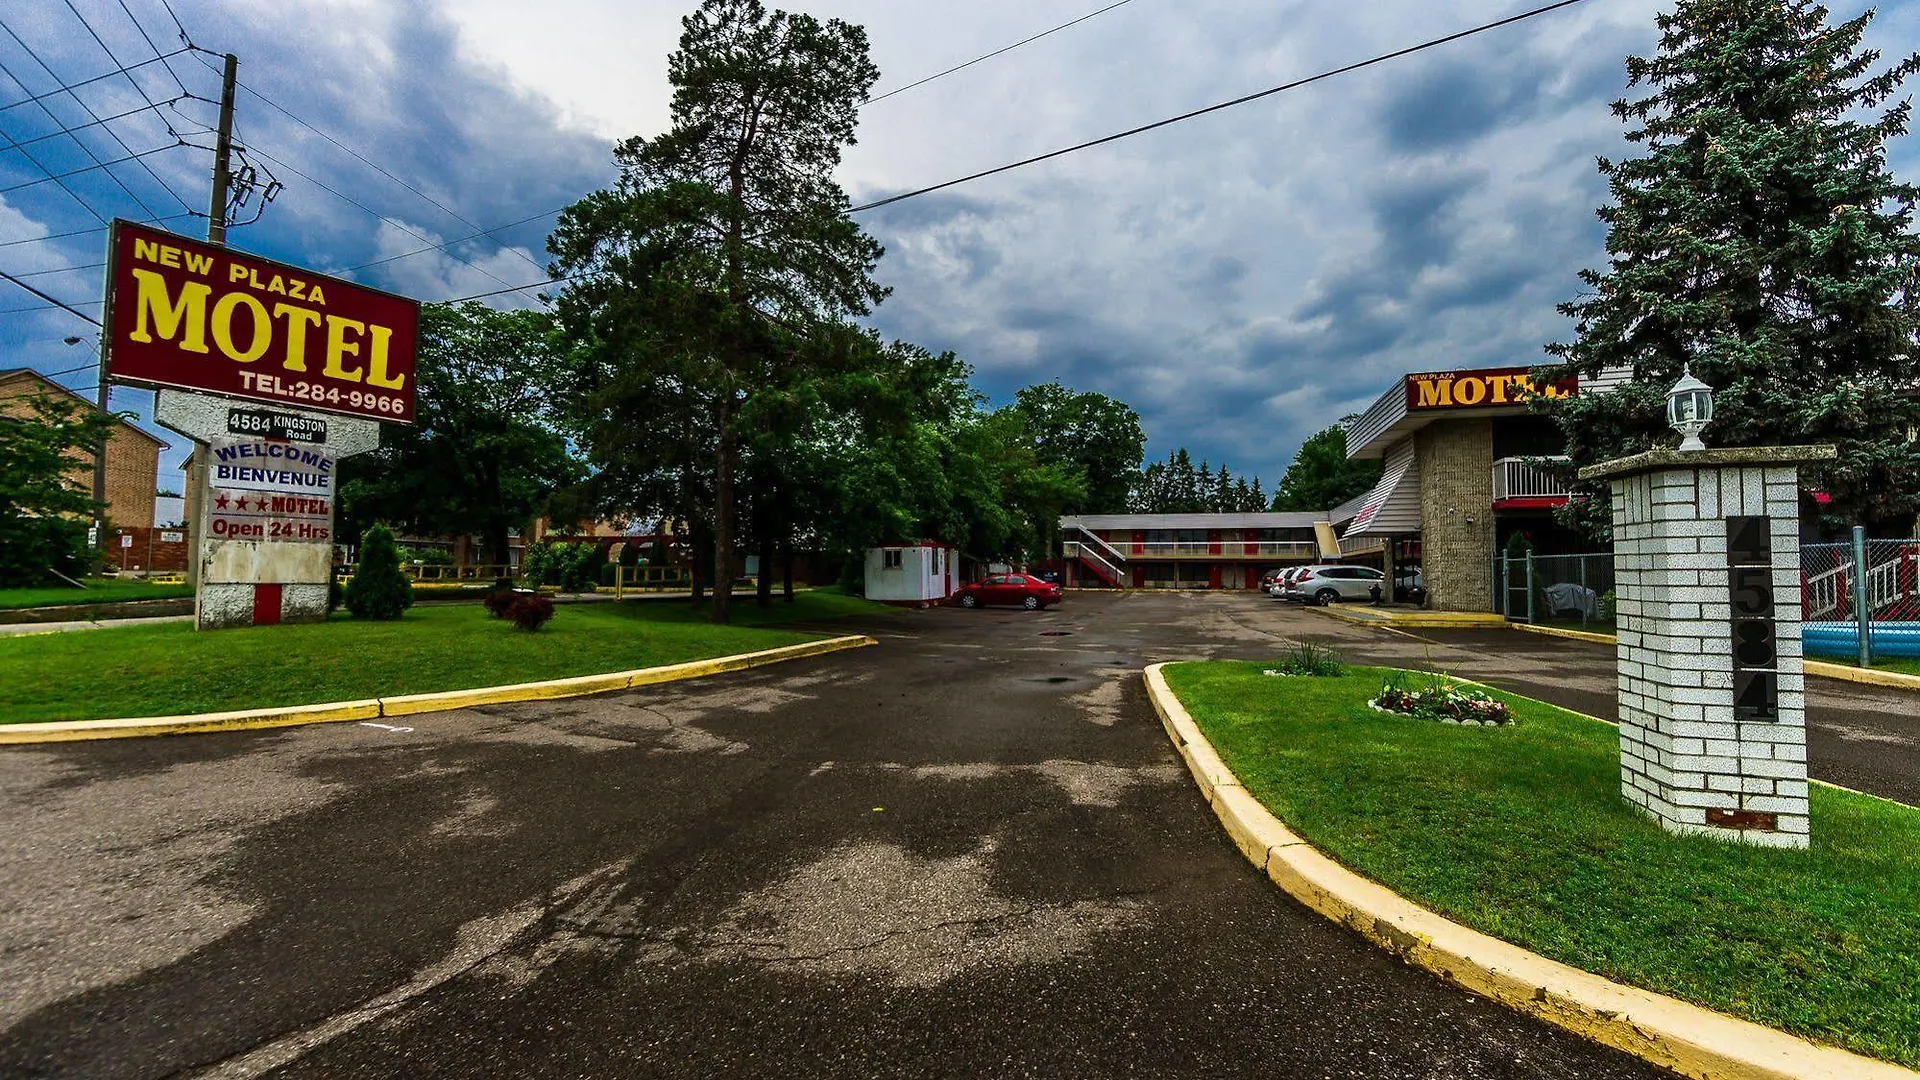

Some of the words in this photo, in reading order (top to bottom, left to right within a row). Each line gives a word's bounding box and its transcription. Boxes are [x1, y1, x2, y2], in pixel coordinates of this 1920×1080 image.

[134, 238, 214, 276] NEW
[229, 263, 326, 306] PLAZA
[129, 268, 405, 391] MOTEL
[1429, 372, 1455, 380] PLAZA
[239, 370, 404, 414] TEL:284-9966
[229, 413, 271, 432] 4584
[273, 415, 325, 432] KINGSTON
[286, 429, 313, 441] Road
[215, 442, 333, 473] WELCOME
[217, 464, 329, 488] BIENVENUE
[271, 496, 329, 516] MOTEL
[212, 518, 264, 538] Open
[269, 521, 295, 538] 24
[298, 523, 330, 540] Hrs
[1730, 515, 1774, 721] 4584
